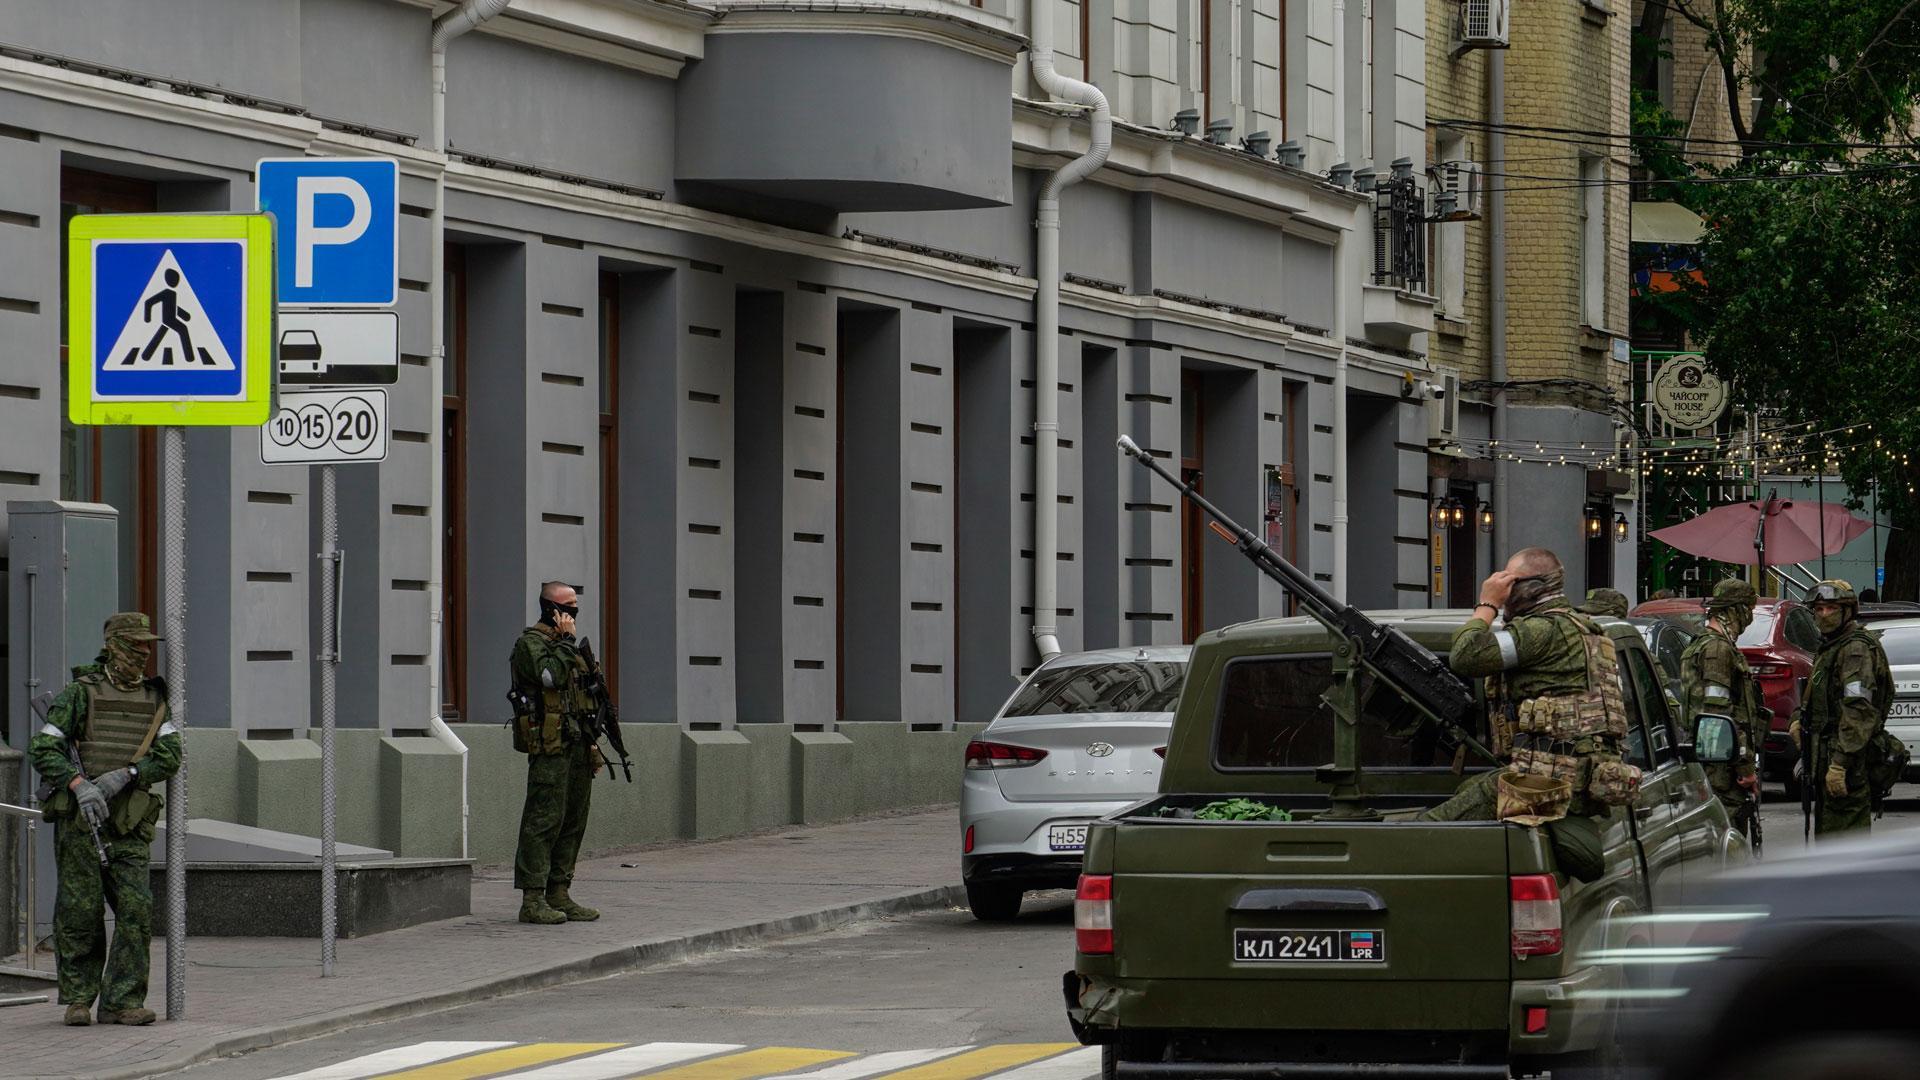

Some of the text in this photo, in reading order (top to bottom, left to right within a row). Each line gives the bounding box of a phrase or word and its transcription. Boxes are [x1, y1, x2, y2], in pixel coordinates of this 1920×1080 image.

[295, 176, 372, 287] P
[1674, 402, 1703, 411] HOUSE
[276, 410, 371, 440] 10 15 20
[1048, 767, 1153, 777] SONATA
[1056, 829, 1088, 844] Н55
[1279, 936, 1332, 958] 2241
[1351, 949, 1373, 958] LPR
